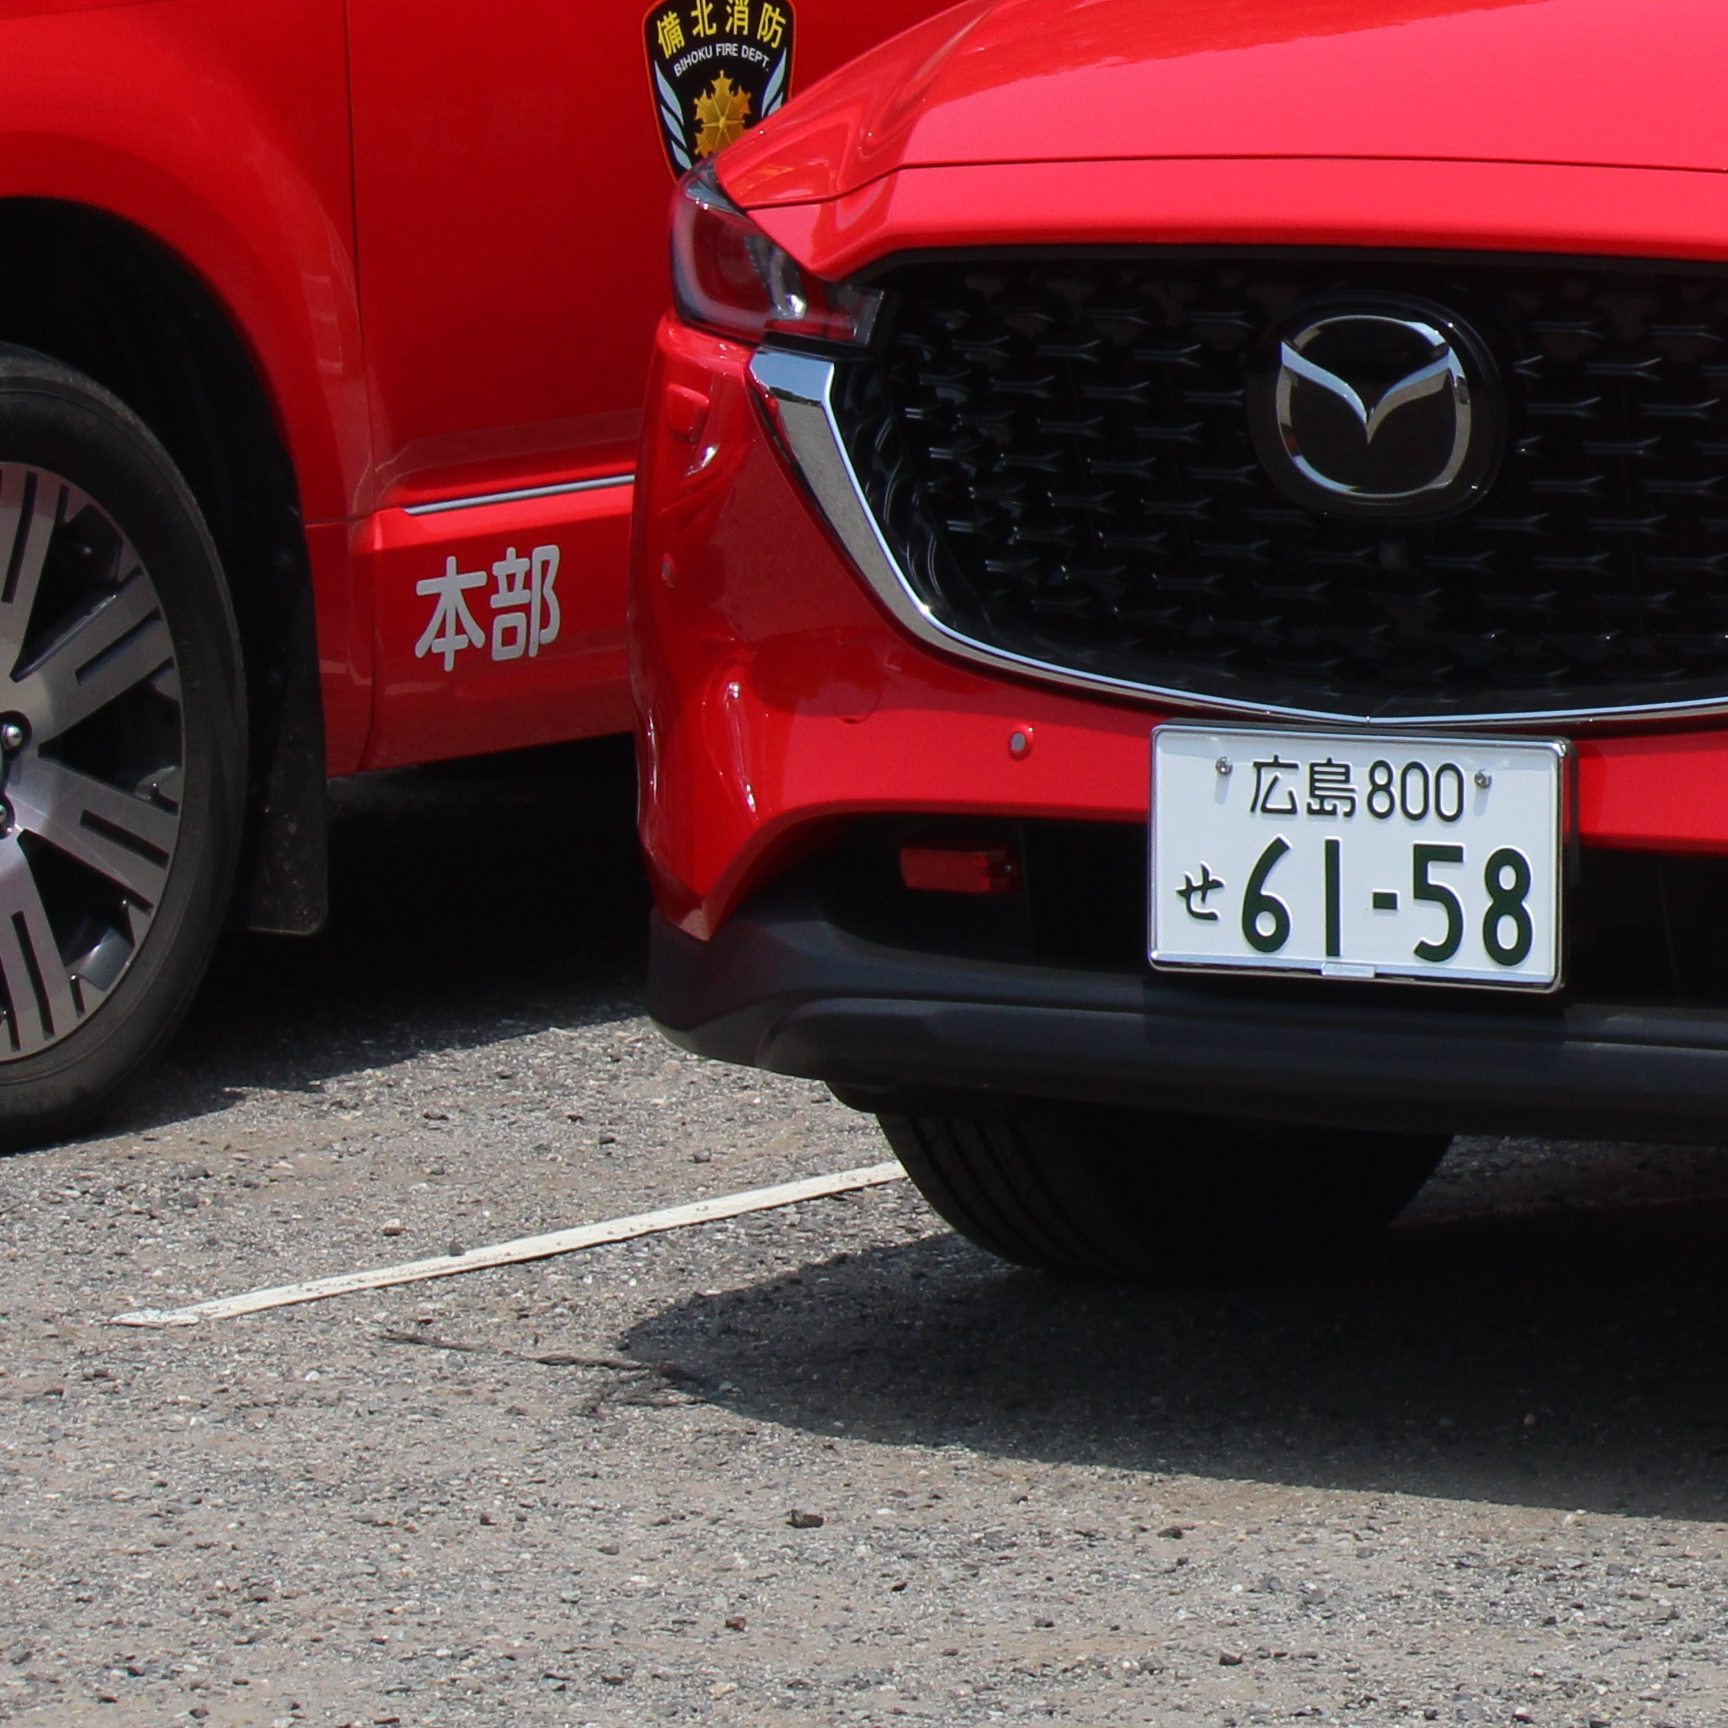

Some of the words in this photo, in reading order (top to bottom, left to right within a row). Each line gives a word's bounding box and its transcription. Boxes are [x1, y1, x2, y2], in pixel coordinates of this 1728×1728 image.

[673, 45, 714, 77] BIHOKU
[716, 43, 739, 57] FIRE
[741, 45, 770, 72] DEPT.
[414, 544, 561, 672] 本部
[1249, 754, 1465, 822] 広島800
[1176, 860, 1226, 921] せ
[1241, 834, 1533, 967] 61-58
